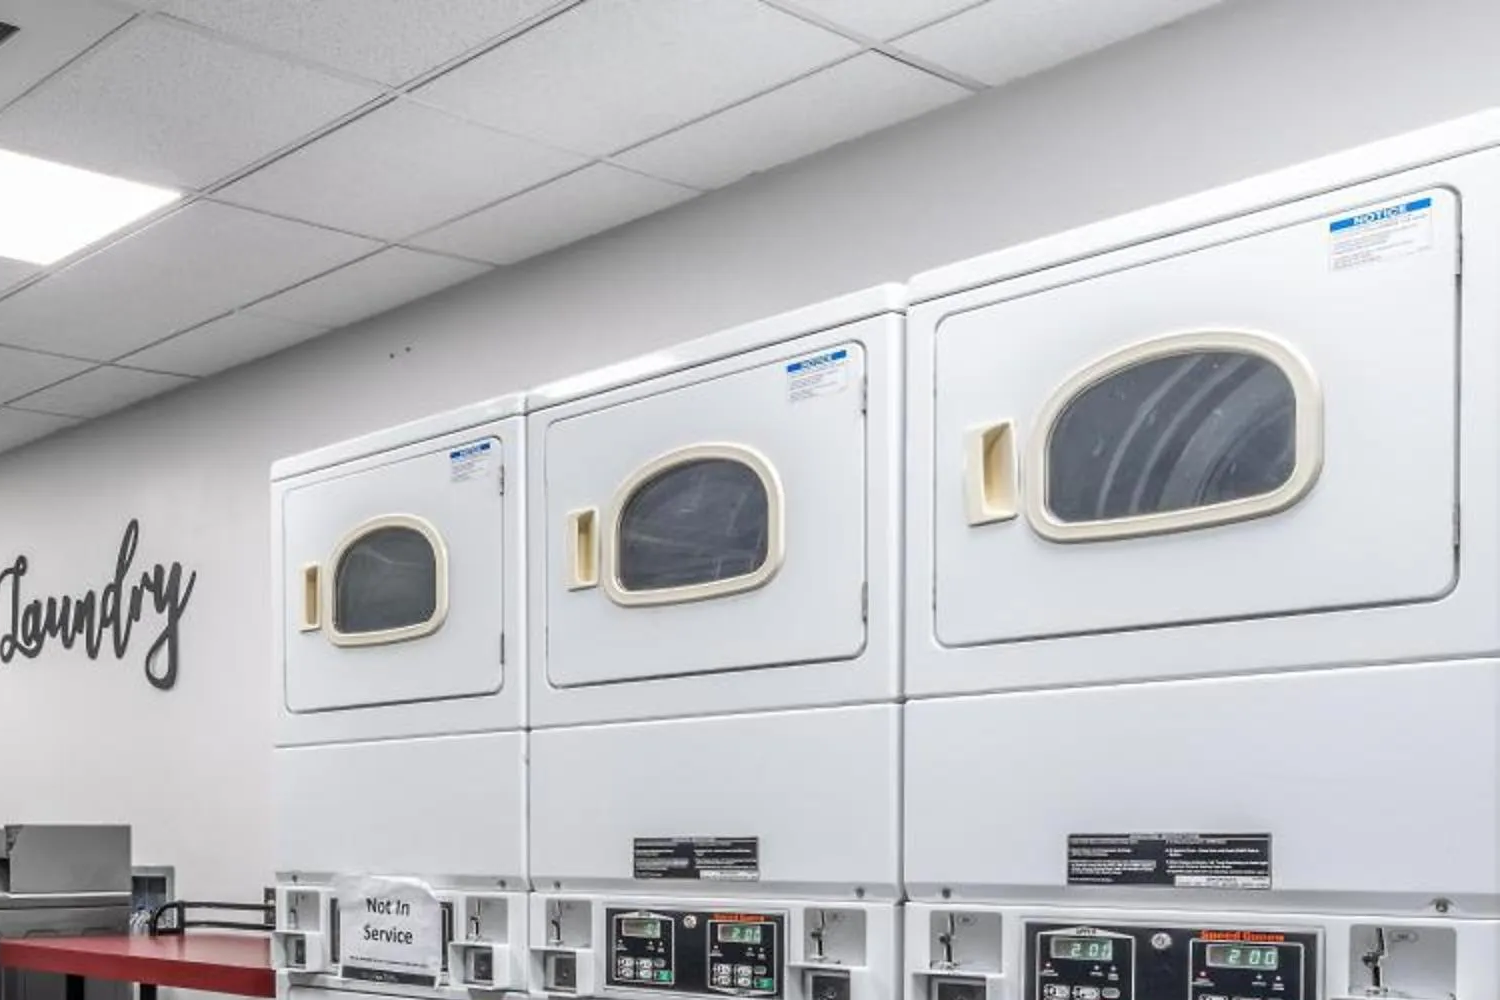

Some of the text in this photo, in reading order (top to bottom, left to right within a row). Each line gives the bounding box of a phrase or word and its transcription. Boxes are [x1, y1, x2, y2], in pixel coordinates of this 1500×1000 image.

[366, 898, 411, 916] Not In
[363, 923, 414, 945] Service
